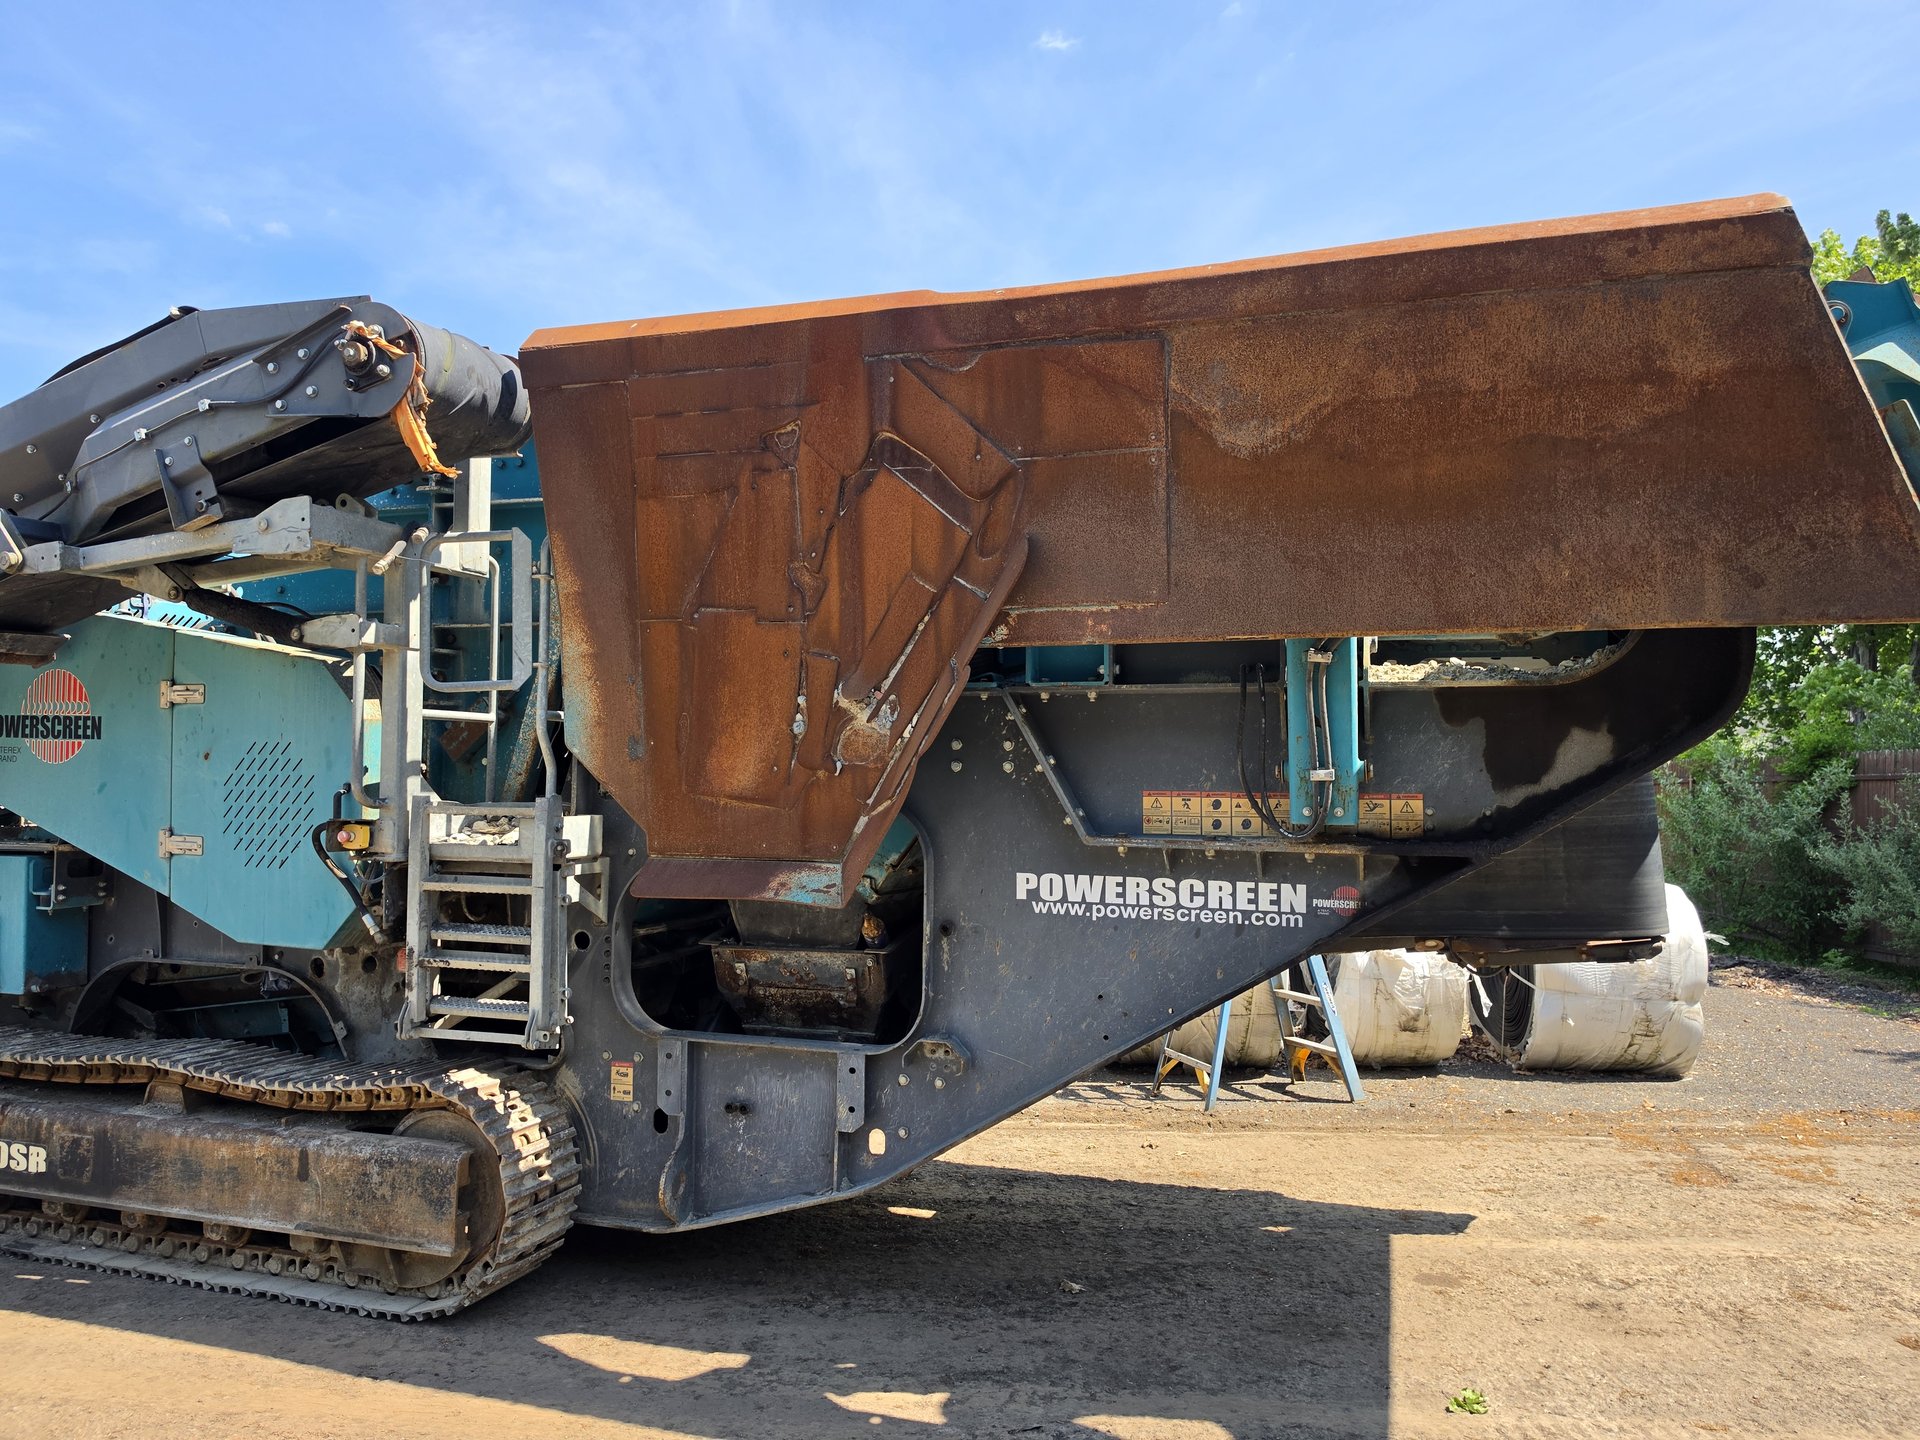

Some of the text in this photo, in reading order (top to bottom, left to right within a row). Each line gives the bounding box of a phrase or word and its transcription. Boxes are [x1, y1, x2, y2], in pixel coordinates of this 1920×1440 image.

[1016, 872, 1307, 914] POWERSCREEN
[1312, 898, 1368, 909] POWERSCRE
[1032, 901, 1303, 928] www.powerscreen.com
